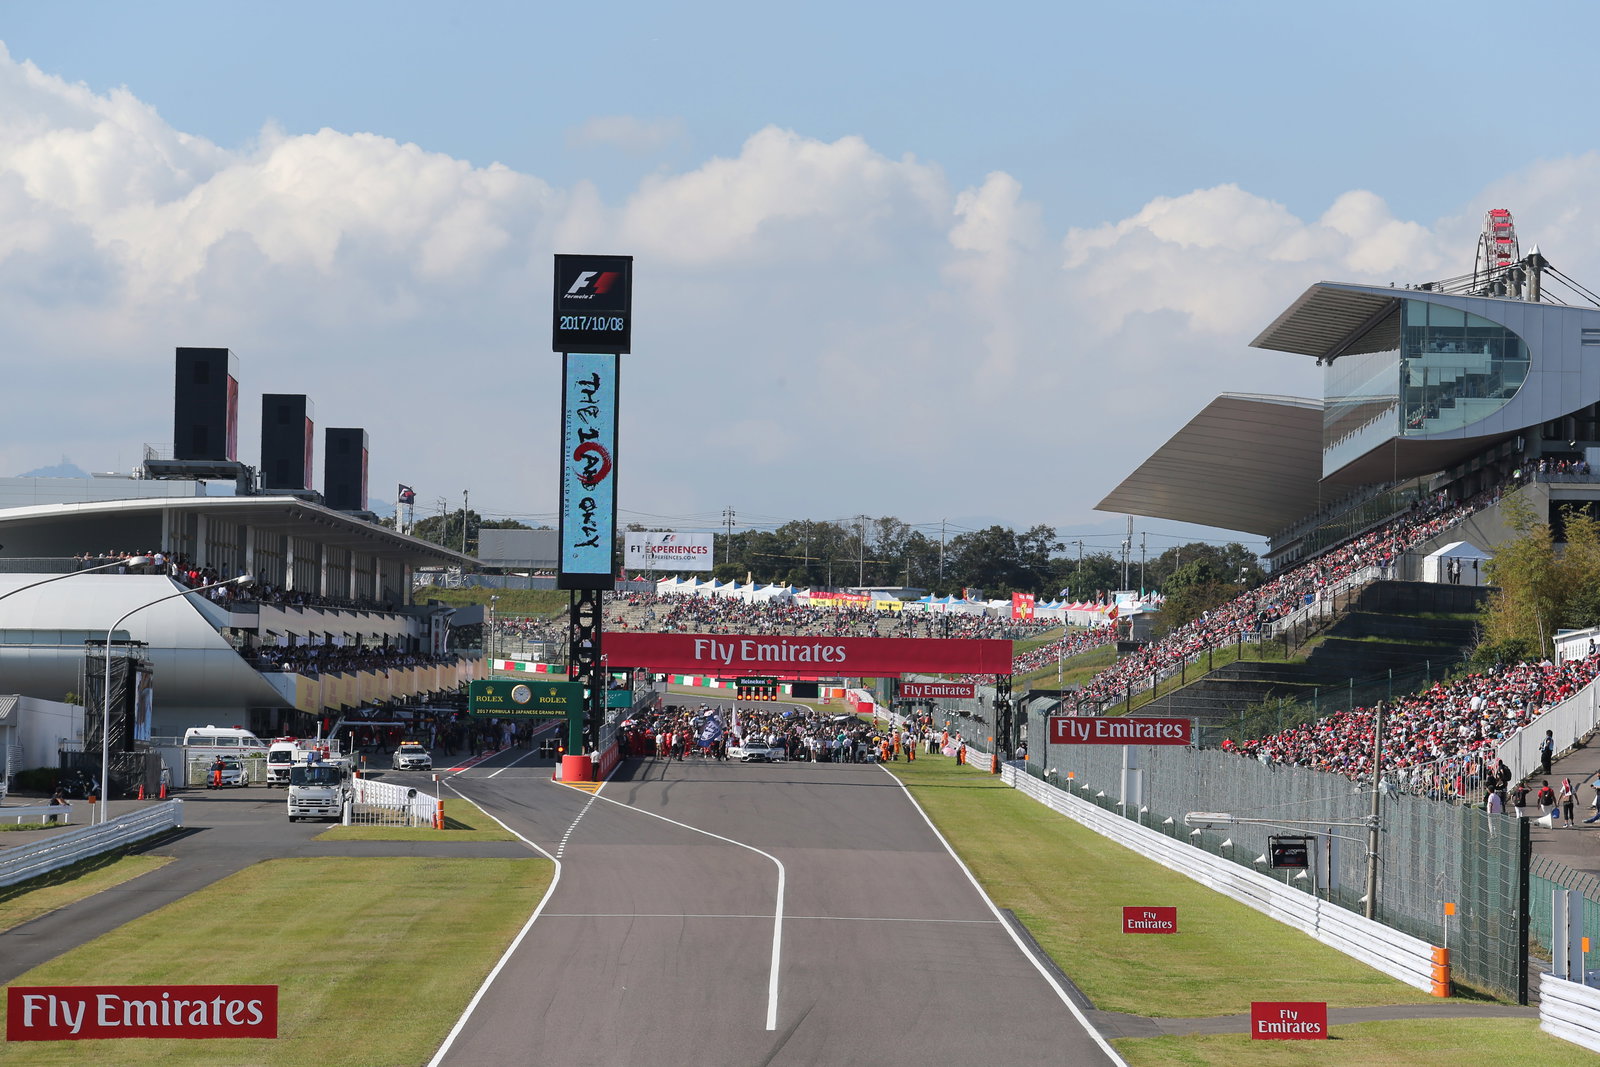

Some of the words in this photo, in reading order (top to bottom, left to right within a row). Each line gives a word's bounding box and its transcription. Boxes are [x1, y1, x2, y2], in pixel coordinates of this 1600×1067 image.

[560, 316, 624, 331] 2017/10/08
[574, 372, 601, 425] THE
[580, 452, 600, 492] AND
[573, 497, 601, 548] ONLY
[631, 545, 641, 553] F1
[645, 545, 708, 554] EXPERIENCES
[694, 638, 735, 665] Fly
[740, 639, 847, 663] Emirates
[904, 685, 922, 697] Fly
[924, 685, 971, 696] Emirates
[539, 696, 567, 704] ROLEX
[1057, 720, 1090, 741] Fly
[1095, 720, 1183, 738] Emirates
[1143, 911, 1157, 920] Fly
[1127, 919, 1173, 929] Emirates
[22, 994, 86, 1034] Fly
[96, 992, 263, 1026] Emirates
[1280, 1009, 1298, 1021] Fly
[1258, 1020, 1321, 1033] Emirates
